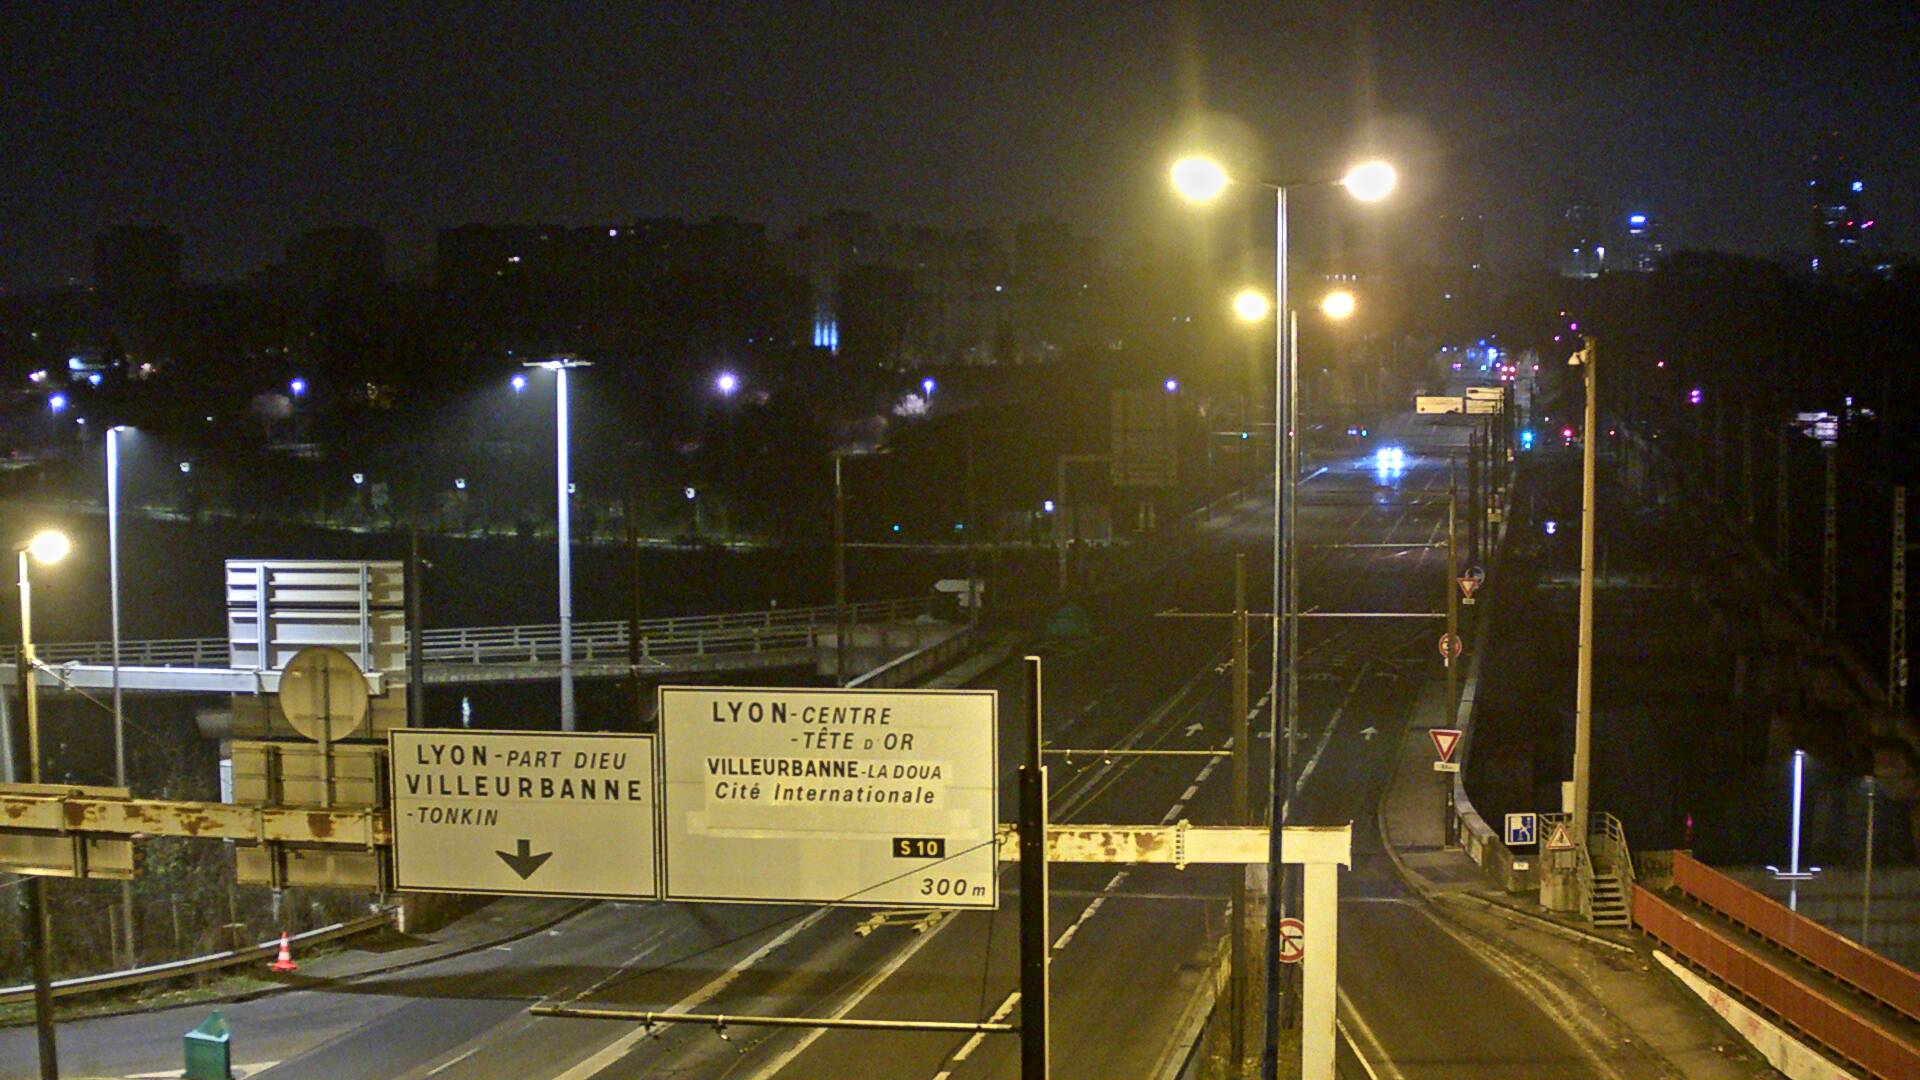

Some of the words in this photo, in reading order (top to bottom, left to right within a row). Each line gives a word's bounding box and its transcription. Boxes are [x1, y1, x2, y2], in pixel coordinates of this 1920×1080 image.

[574, 752, 627, 769] DIEU
[893, 765, 942, 780] DOUA
[406, 774, 641, 801] VILLEURBANNE
[715, 782, 760, 799] Cité
[774, 783, 935, 804] Internationale
[921, 878, 967, 896] 300
[972, 886, 986, 896] m
